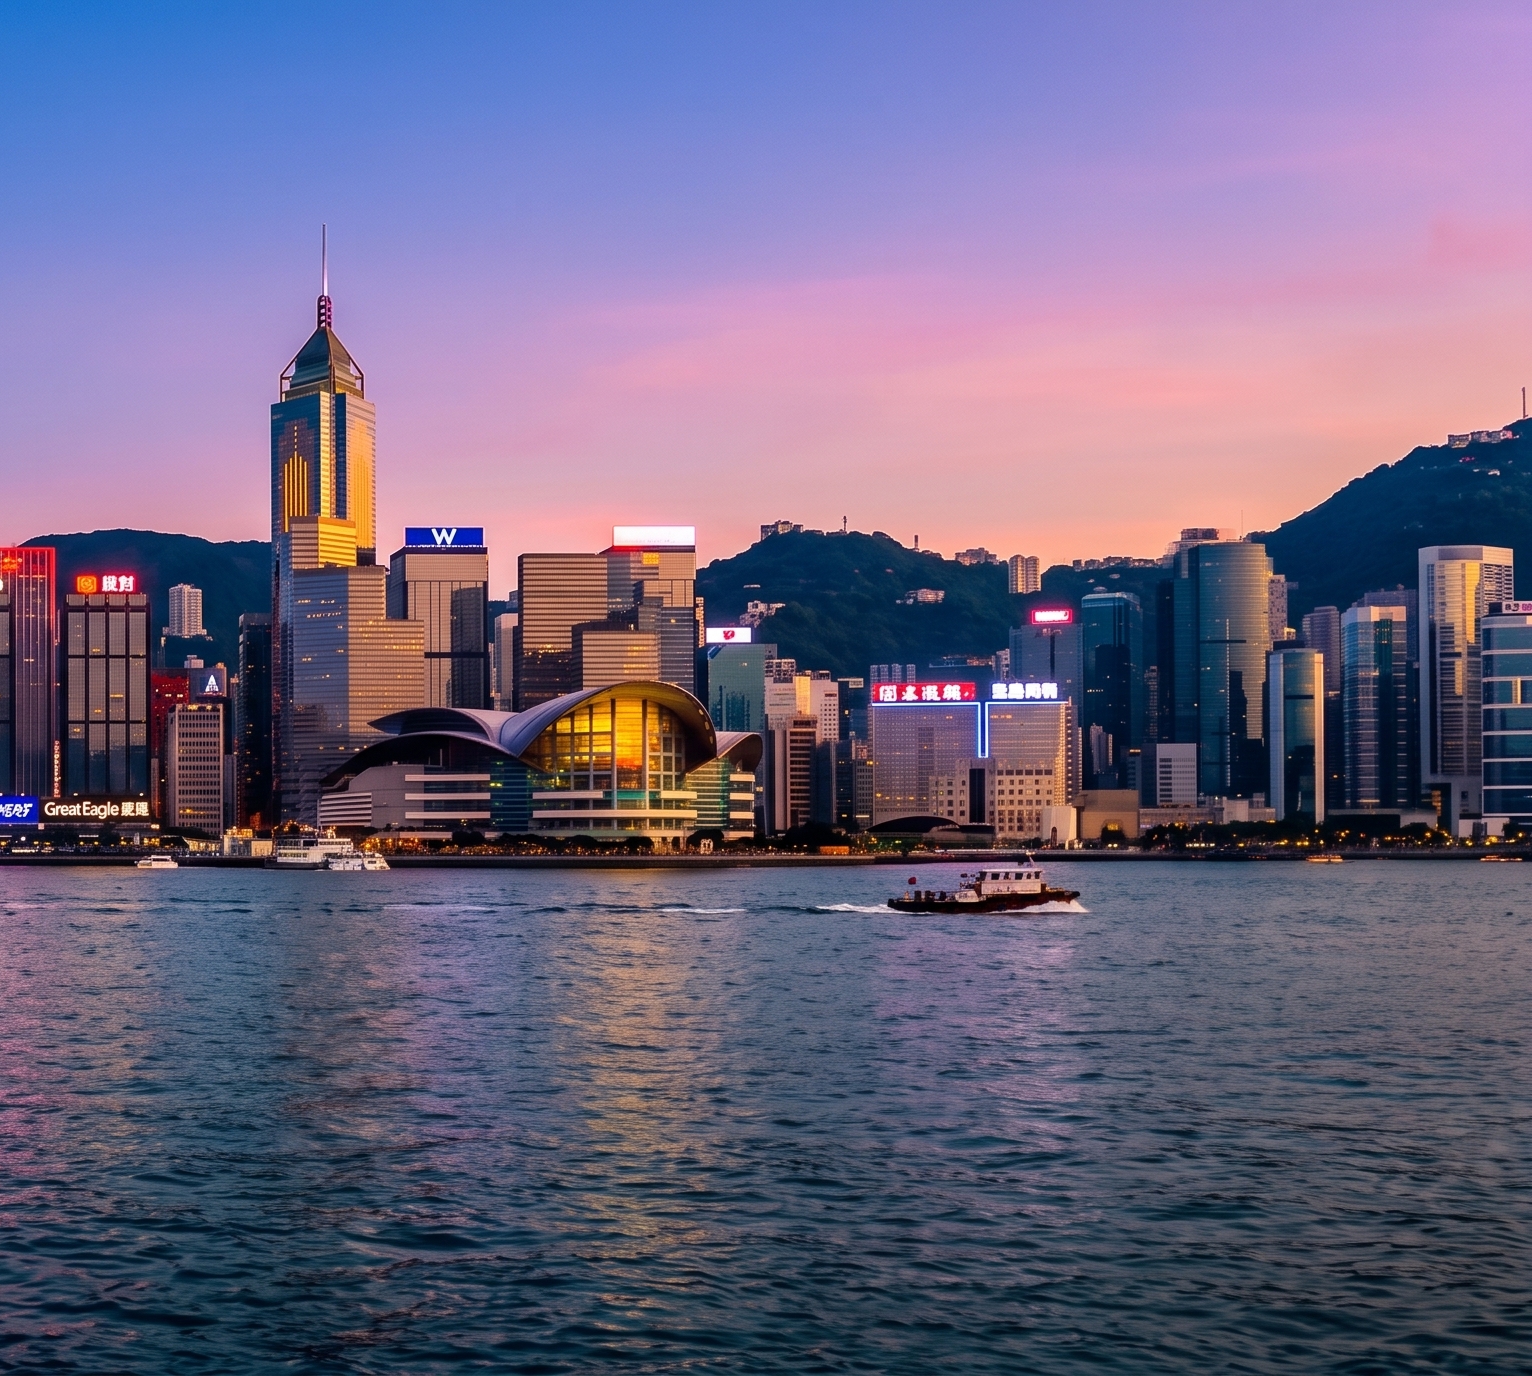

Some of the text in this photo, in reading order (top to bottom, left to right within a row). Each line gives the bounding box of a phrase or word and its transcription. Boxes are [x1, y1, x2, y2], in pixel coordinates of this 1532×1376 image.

[431, 528, 457, 545] W
[44, 802, 82, 816] Great
[82, 801, 119, 819] Eagle
